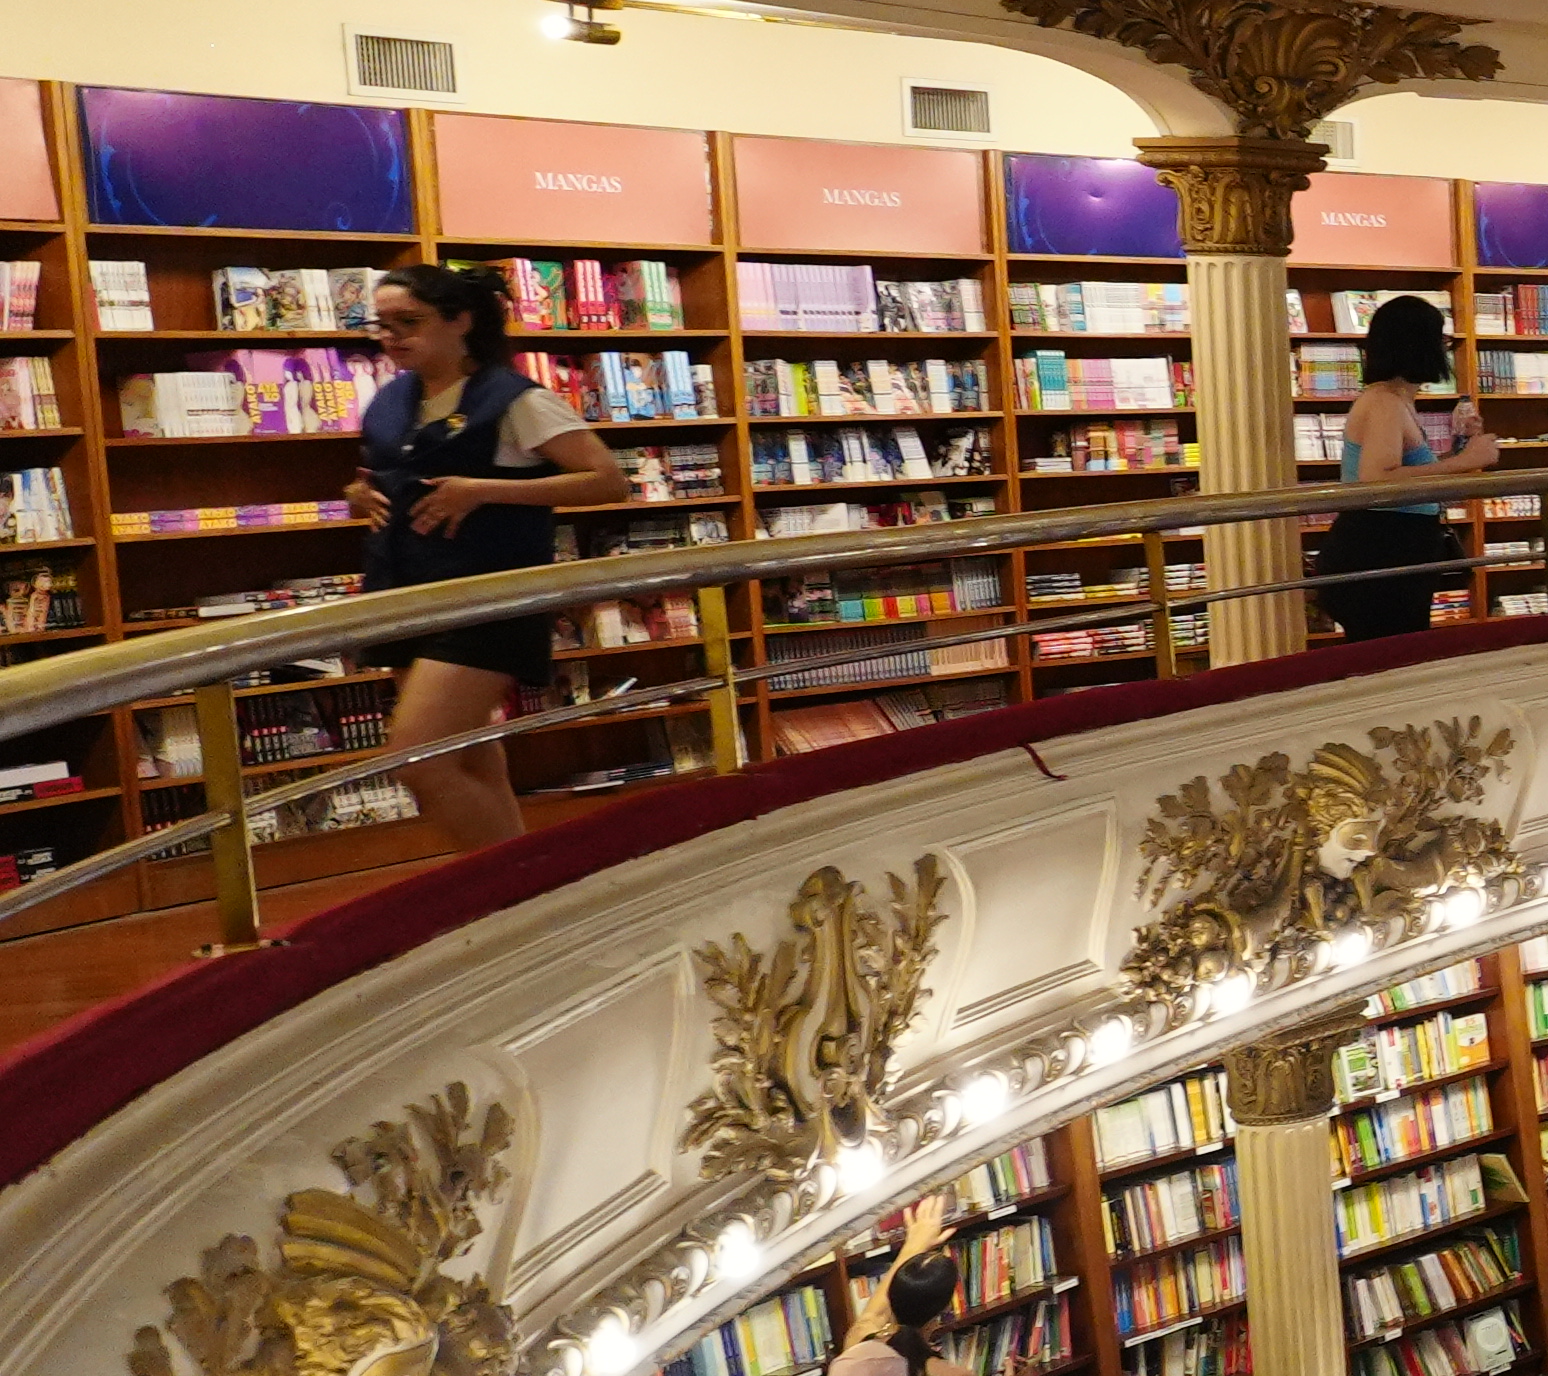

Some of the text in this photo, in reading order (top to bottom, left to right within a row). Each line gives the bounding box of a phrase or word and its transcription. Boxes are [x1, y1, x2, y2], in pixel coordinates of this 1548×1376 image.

[534, 171, 622, 194] MANGAS
[823, 188, 901, 207] MANGAS
[1320, 211, 1386, 228] MANGAS
